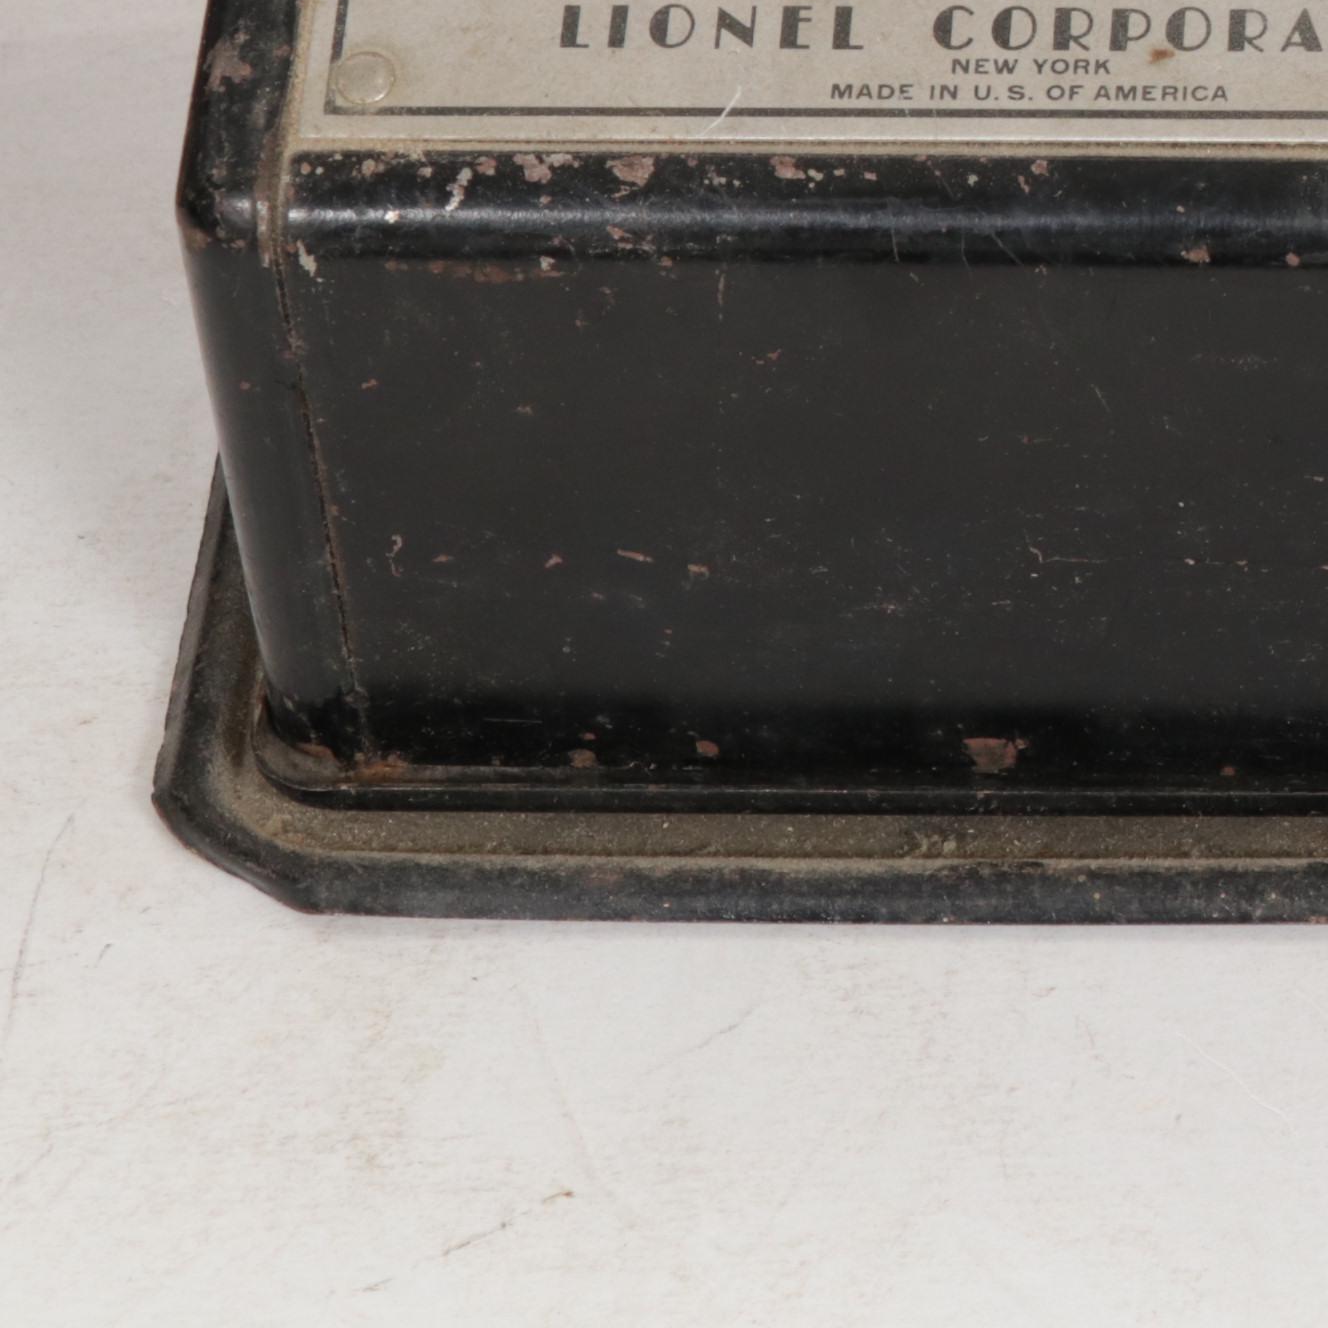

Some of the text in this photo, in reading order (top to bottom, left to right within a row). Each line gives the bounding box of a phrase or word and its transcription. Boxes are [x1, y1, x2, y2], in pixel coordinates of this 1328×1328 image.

[559, 4, 865, 51] LIONEL
[952, 58, 1111, 75] NEW YORK
[831, 83, 915, 101] MADE
[930, 84, 959, 101] IN
[1046, 84, 1083, 101] OF
[1094, 85, 1228, 102] AMERICA
